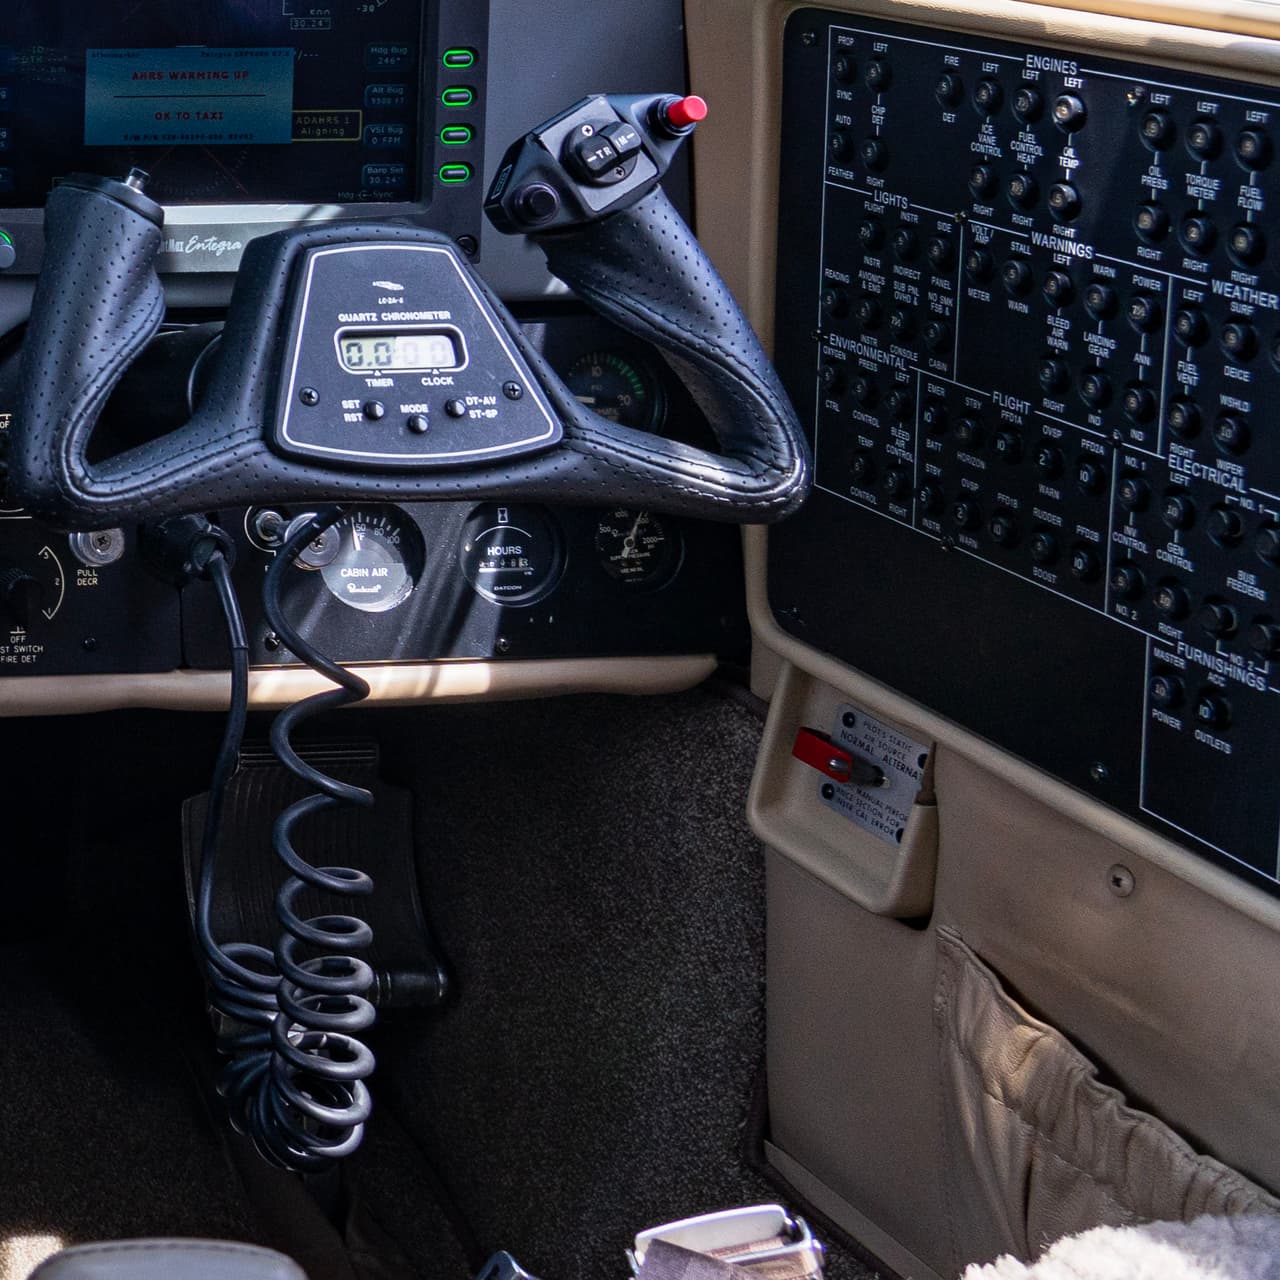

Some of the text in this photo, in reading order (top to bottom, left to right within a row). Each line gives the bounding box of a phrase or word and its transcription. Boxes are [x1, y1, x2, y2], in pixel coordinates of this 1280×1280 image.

[1025, 54, 1078, 75] ENGINES
[1064, 77, 1083, 89] LEFT
[874, 190, 909, 209] LIGHTS
[1031, 232, 1094, 259] WARNINGS
[1212, 280, 1278, 309] WEATHER
[338, 310, 452, 322] QUARTZ CHRONOMETER
[829, 333, 907, 371] ENVIRONMENTAL
[365, 378, 394, 387] TIMER
[421, 376, 455, 386] CLOCK
[400, 404, 429, 413] MODE
[992, 392, 1031, 415] FLIGHT
[1168, 455, 1247, 494] ELECTRICAL
[487, 545, 522, 556] HOURS
[340, 568, 388, 578] CABIN AIR
[1177, 641, 1266, 692] FURNISHINGS
